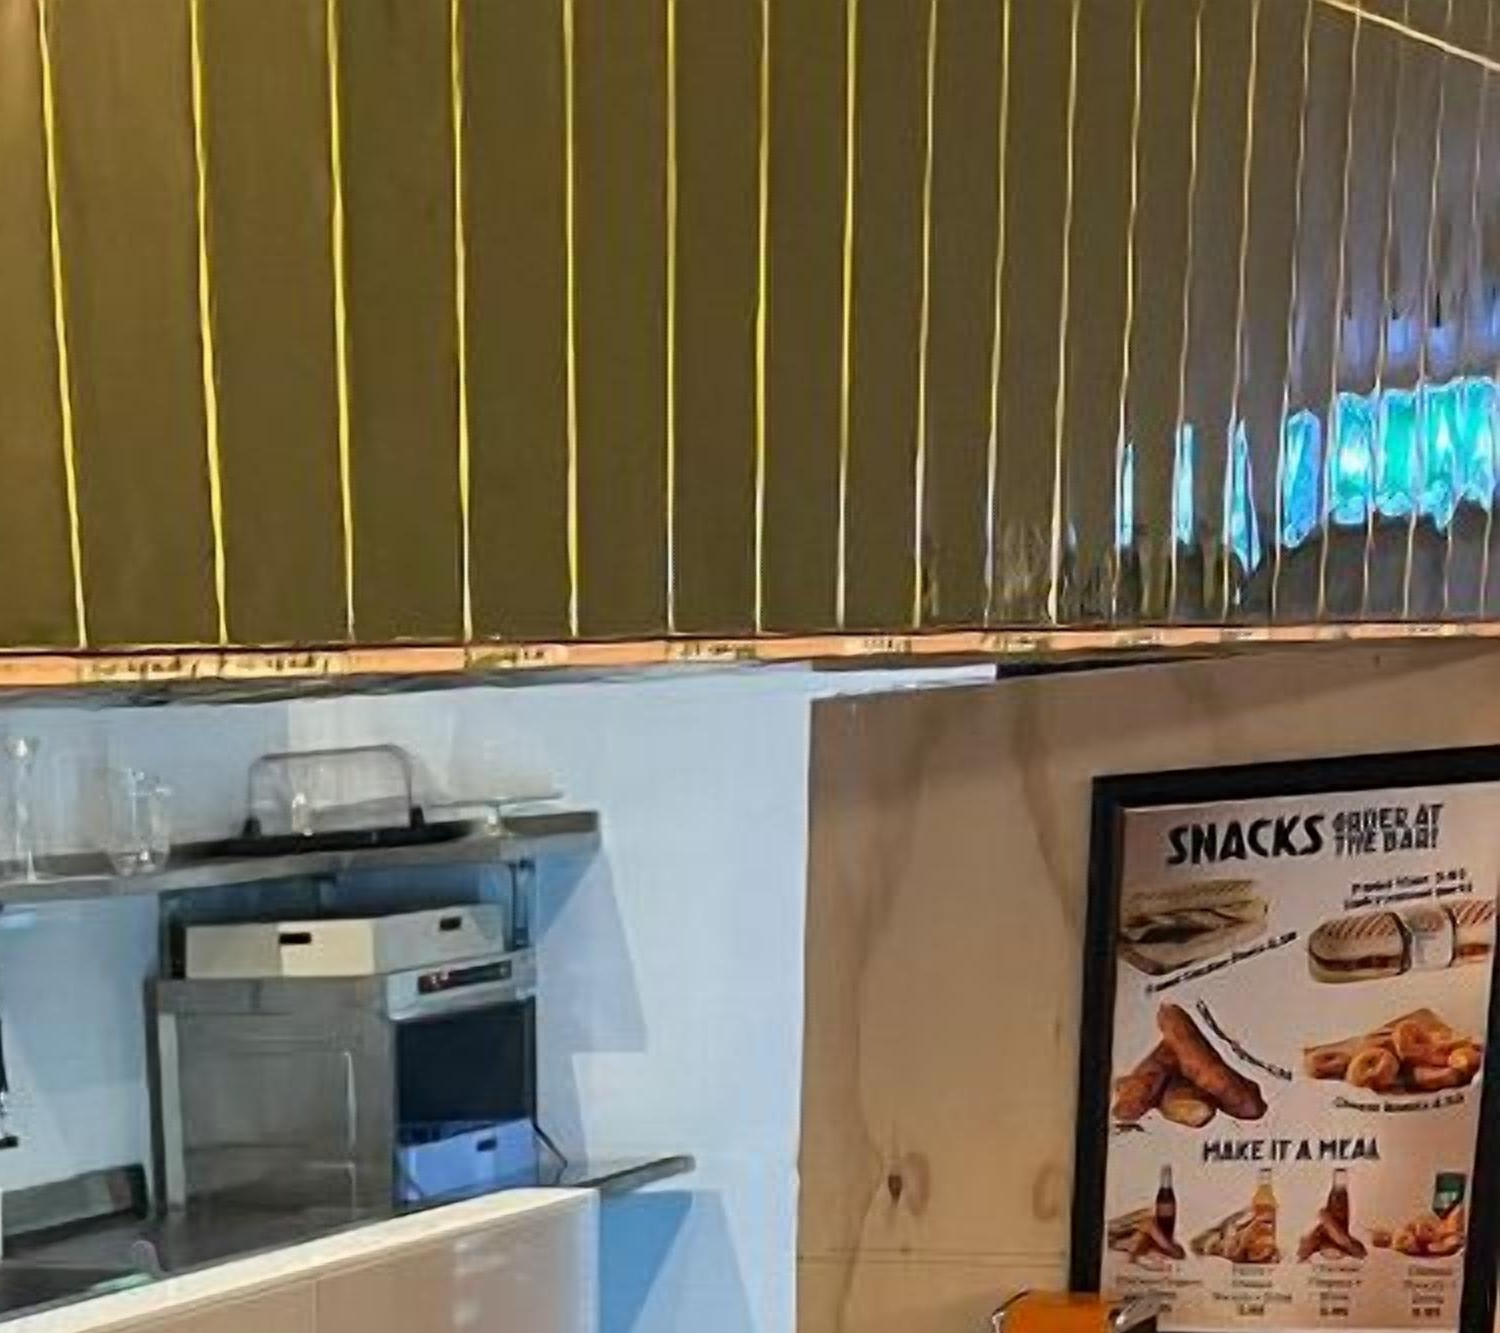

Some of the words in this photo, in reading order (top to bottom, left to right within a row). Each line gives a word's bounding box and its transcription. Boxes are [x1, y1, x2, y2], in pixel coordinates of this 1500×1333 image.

[1332, 807, 1409, 833] ORDER
[1414, 804, 1443, 826] AT
[1166, 815, 1324, 866] SNACKS
[1334, 829, 1377, 856] THE
[1203, 1139, 1264, 1162] MAKE
[1271, 1139, 1292, 1161] IT
[1296, 1139, 1312, 1161] A
[1319, 1137, 1381, 1161] MEAL
